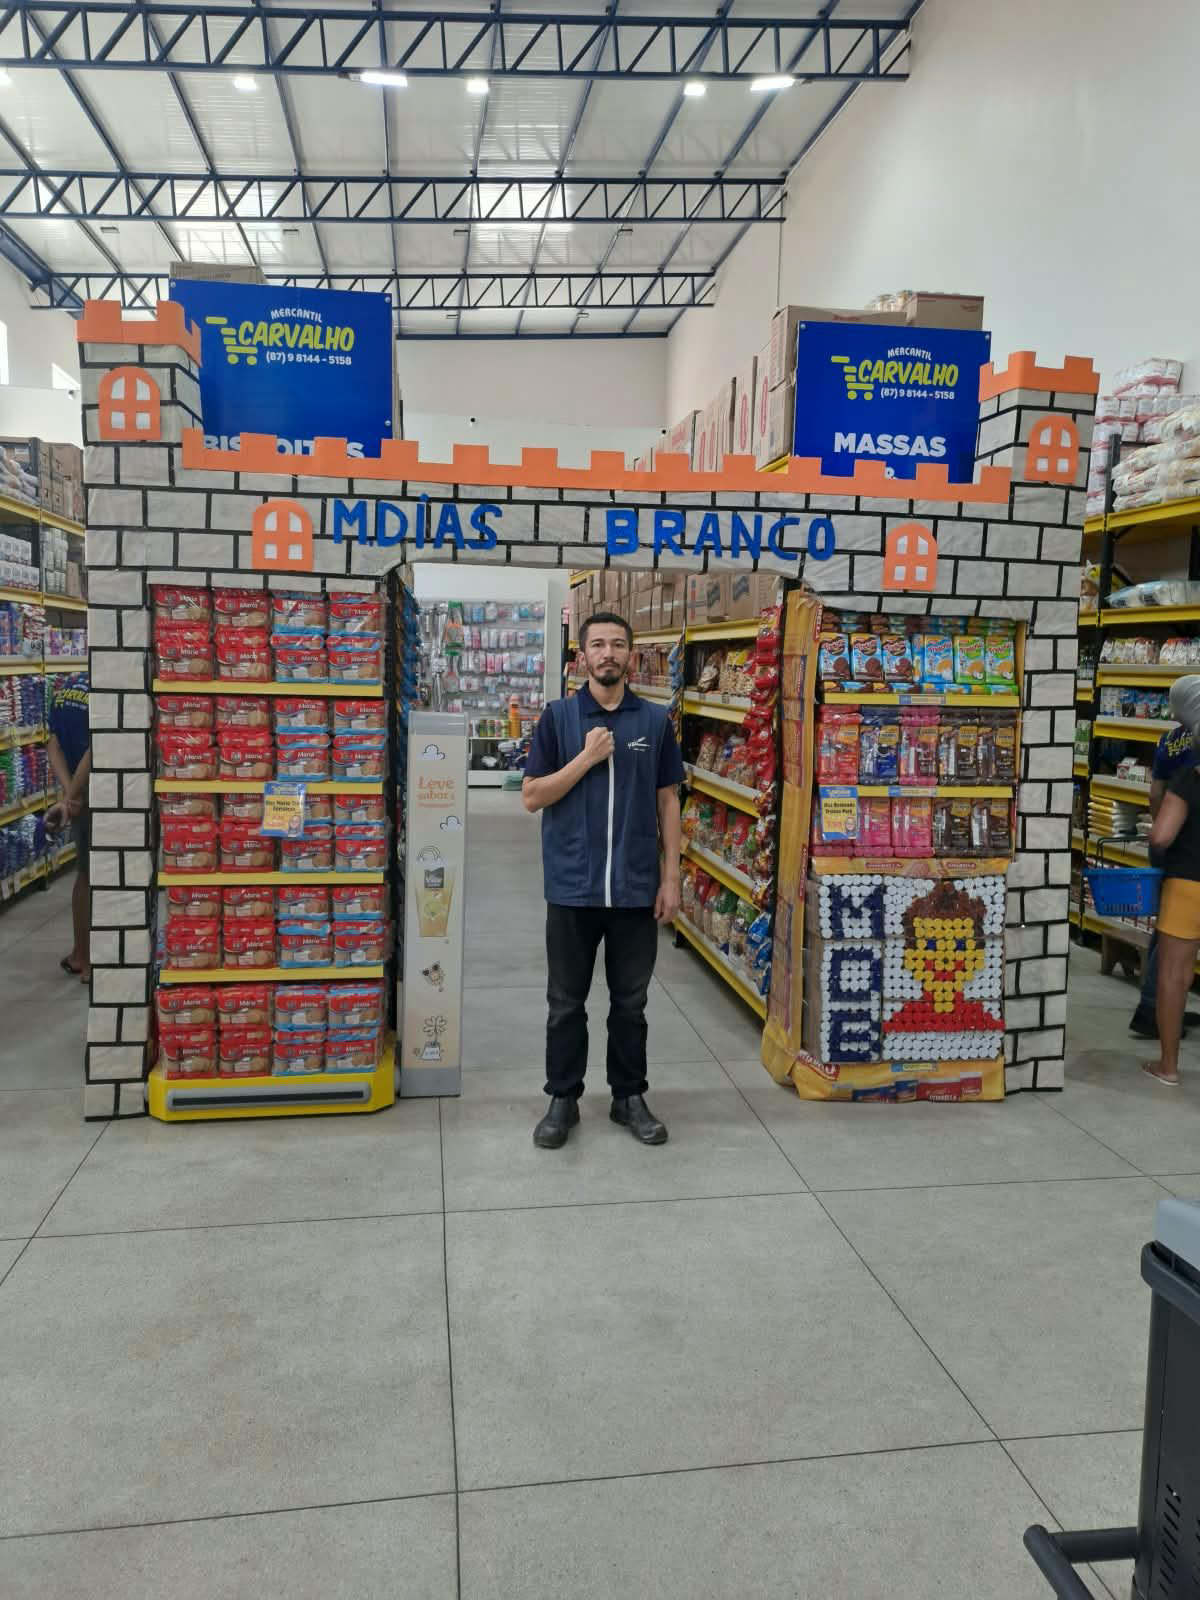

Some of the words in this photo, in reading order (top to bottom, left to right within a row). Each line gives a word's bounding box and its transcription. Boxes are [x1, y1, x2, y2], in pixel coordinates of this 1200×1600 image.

[270, 308, 323, 323] MERCANTIL
[239, 321, 355, 352] CARVALHO
[266, 351, 286, 365] (87)
[287, 352, 294, 362] 9
[296, 353, 320, 364] 8144
[328, 355, 352, 366] 5158
[887, 347, 932, 361] MERCANTIL
[858, 360, 959, 387] CARVALHO
[880, 387, 898, 400] (87)
[899, 388, 905, 398] 9
[906, 389, 928, 399] 8144
[935, 390, 955, 400] 5158
[203, 434, 365, 459] BISOITS
[834, 431, 947, 458] MASSAS
[606, 509, 836, 562] BRANCO
